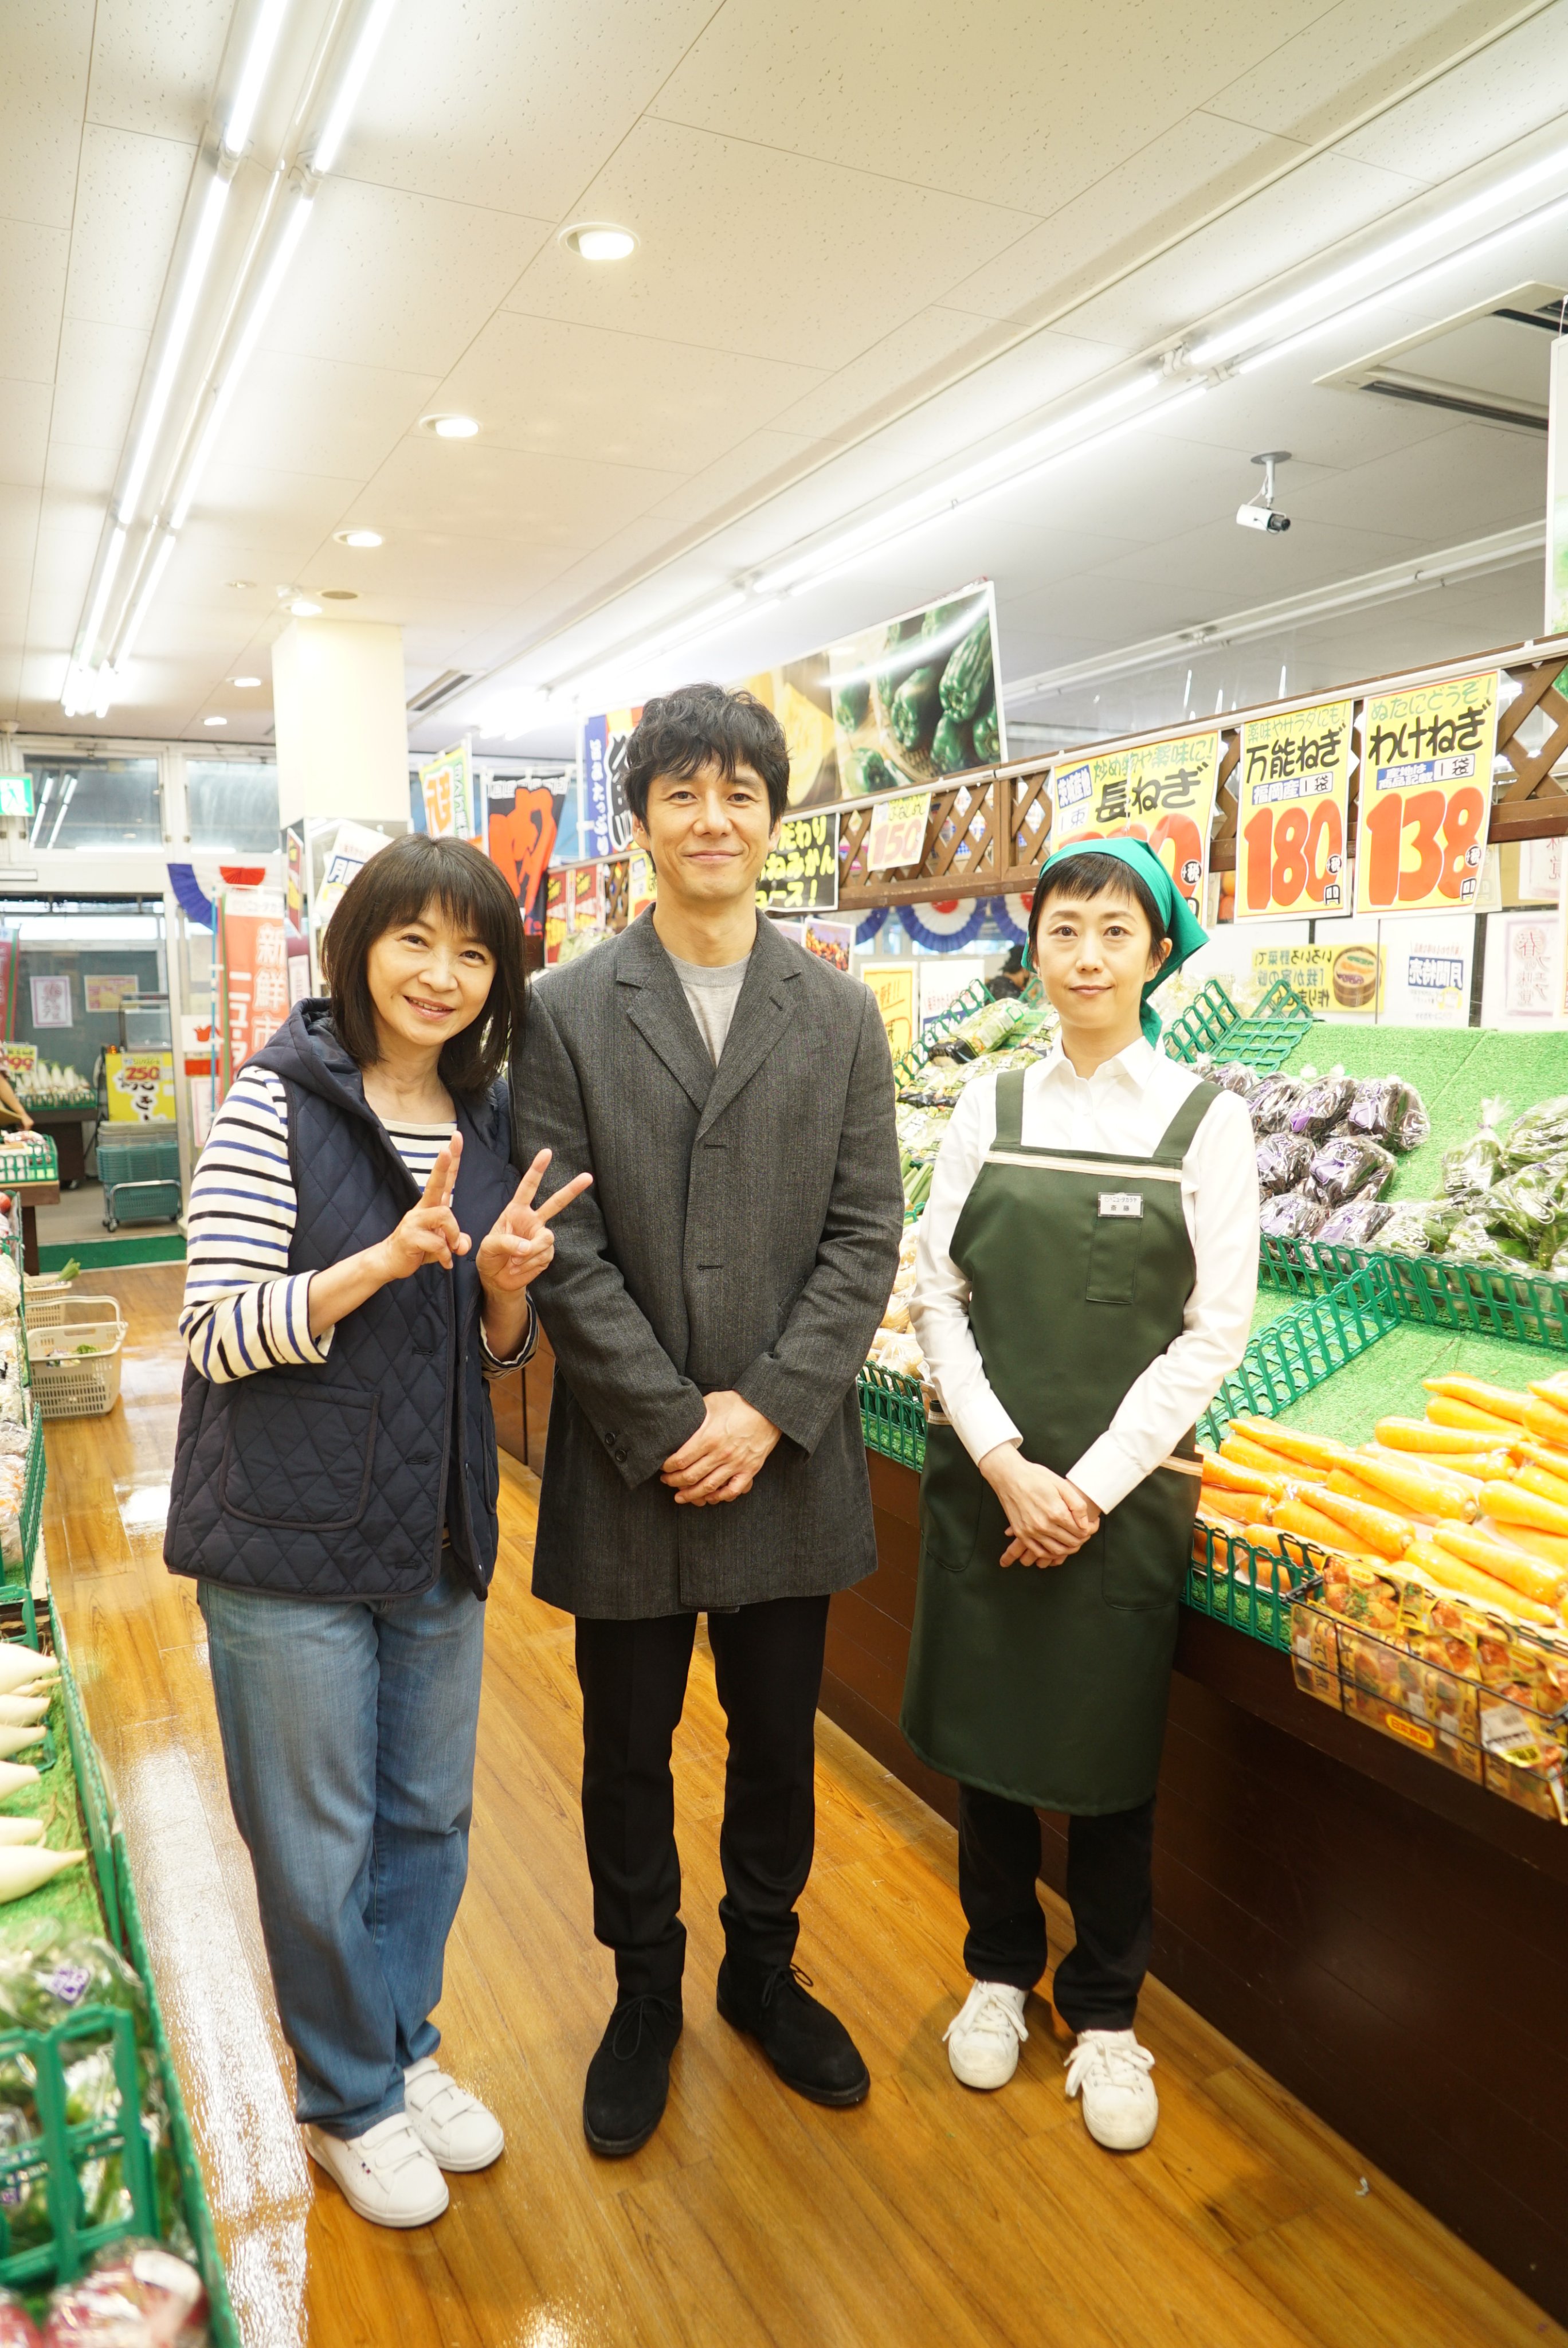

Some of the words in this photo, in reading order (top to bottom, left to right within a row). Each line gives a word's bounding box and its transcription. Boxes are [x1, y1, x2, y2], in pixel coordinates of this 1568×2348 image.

[1246, 723, 1346, 784] 万能ねぎ
[1369, 700, 1492, 765] わけねぎ
[1095, 762, 1209, 823] 長ねぎ
[1254, 780, 1300, 805] 福岡産
[873, 818, 922, 864] 150
[1244, 799, 1343, 910] 180
[1366, 786, 1484, 906] 138
[1324, 885, 1340, 905] 円
[1461, 878, 1477, 901] 円
[125, 1066, 161, 1080] 250
